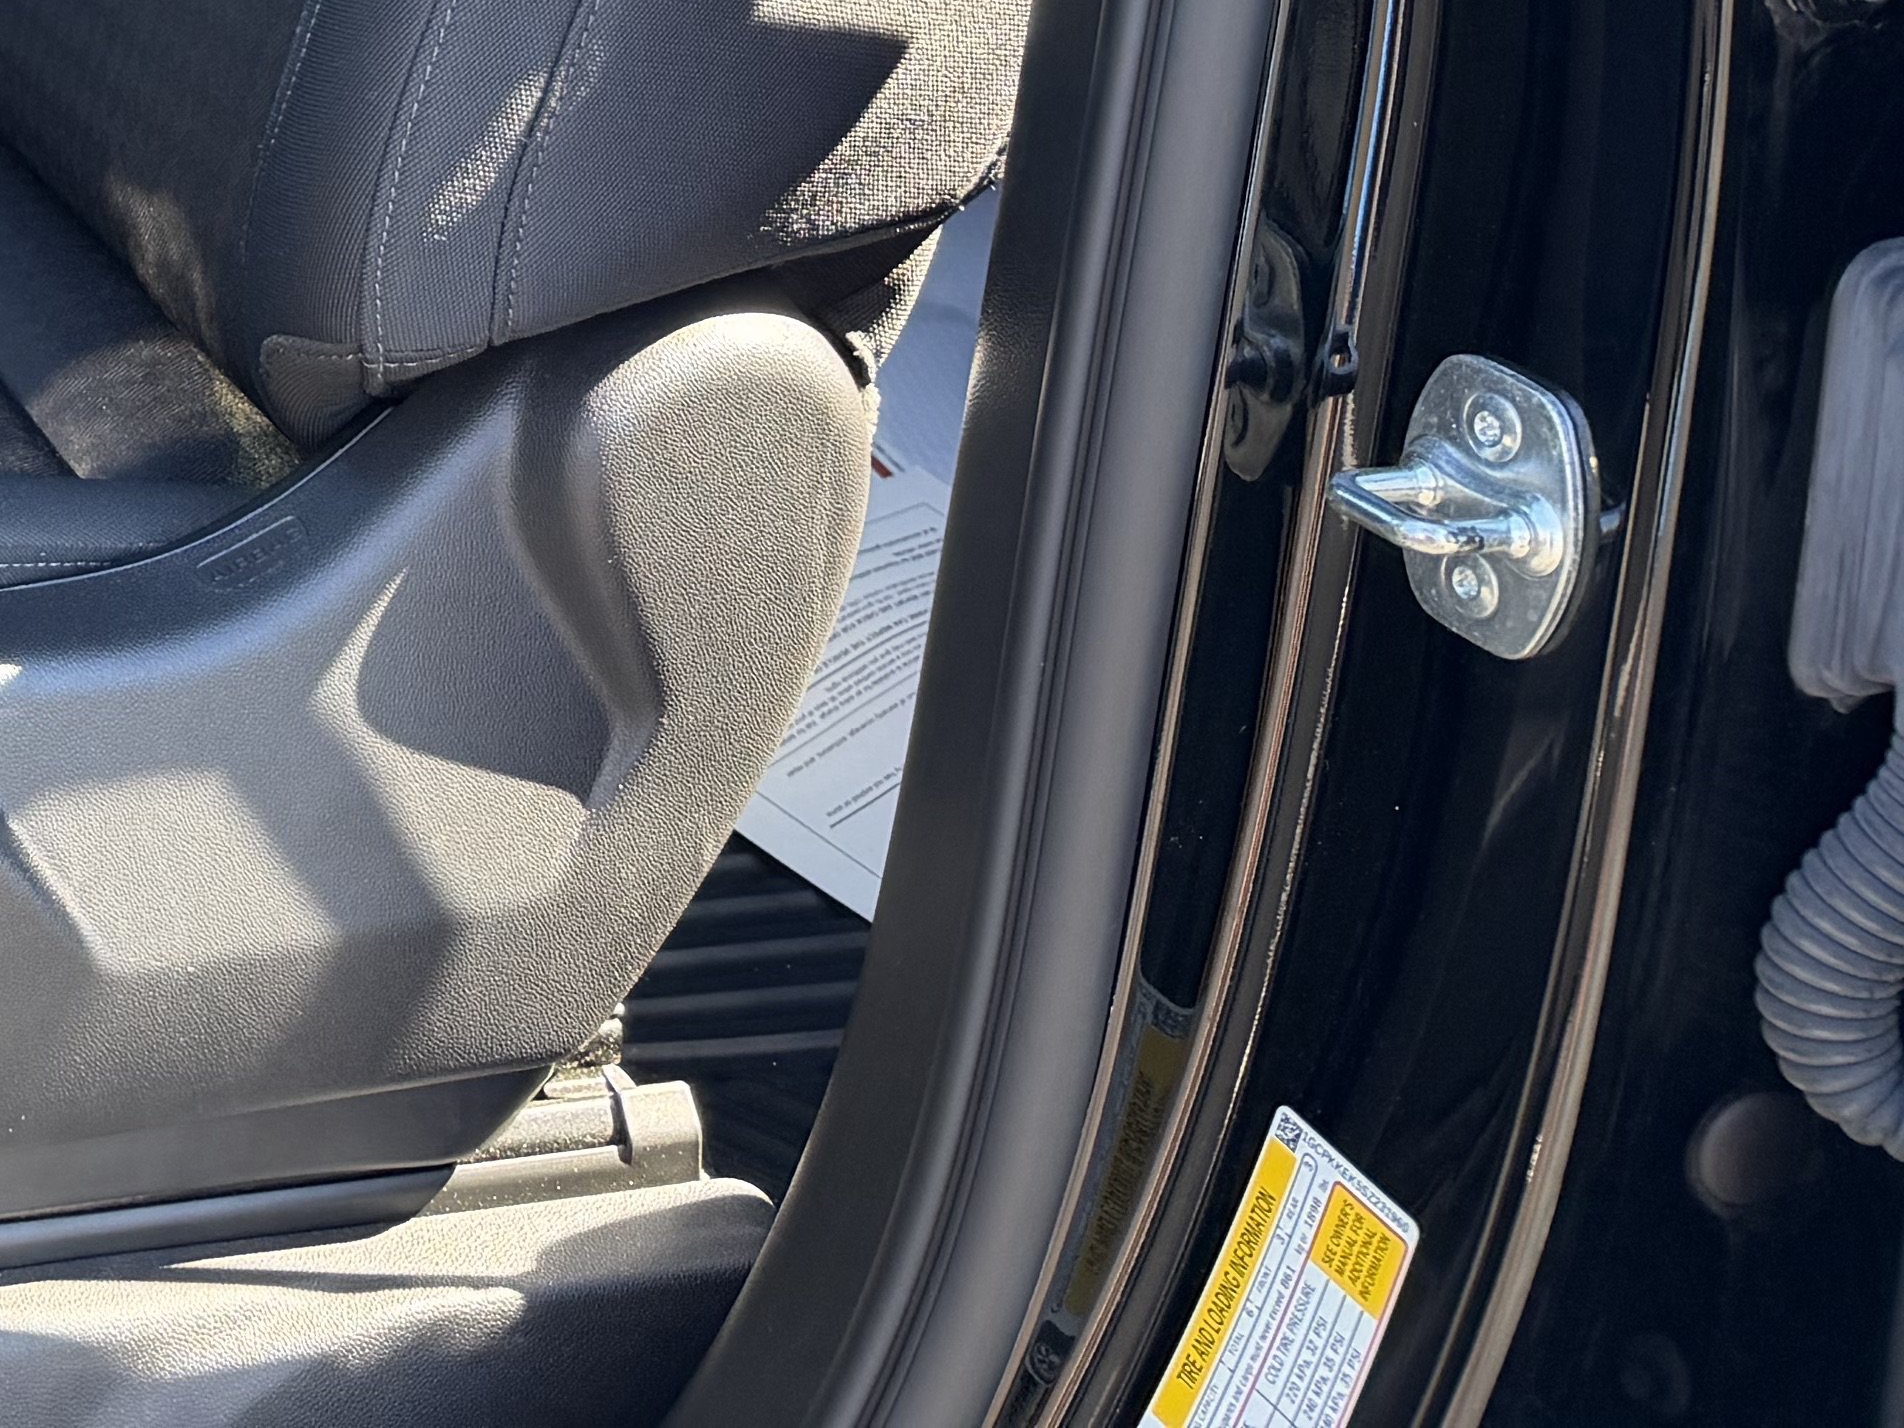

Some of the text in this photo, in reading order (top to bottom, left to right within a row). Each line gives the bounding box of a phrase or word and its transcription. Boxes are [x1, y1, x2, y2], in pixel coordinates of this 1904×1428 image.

[1244, 1307, 1253, 1318] 6
[1256, 1265, 1271, 1293] FRONT
[1274, 1234, 1285, 1245] 3
[1286, 1197, 1299, 1220] REAR
[1303, 1160, 1313, 1172] 3
[1321, 1199, 1354, 1267] SEE OWNER'S
[1334, 1212, 1365, 1277] MANUAL FOR
[1348, 1228, 1377, 1286] ADDITIONAL
[1359, 1233, 1390, 1300] INFORMATION
[1176, 1187, 1275, 1389] TIRE AND LOADING INFORMATION
[1264, 1281, 1315, 1385] COLD TIRE PRESSURE
[1285, 1381, 1300, 1404] 220
[1306, 1339, 1318, 1356] 32
[1313, 1316, 1327, 1338] PSI
[1340, 1372, 1352, 1387] 35
[1347, 1348, 1361, 1369] PSI
[1303, 1398, 1317, 1420] 240
[1323, 1356, 1335, 1372] 35
[1330, 1331, 1345, 1354] PSI
